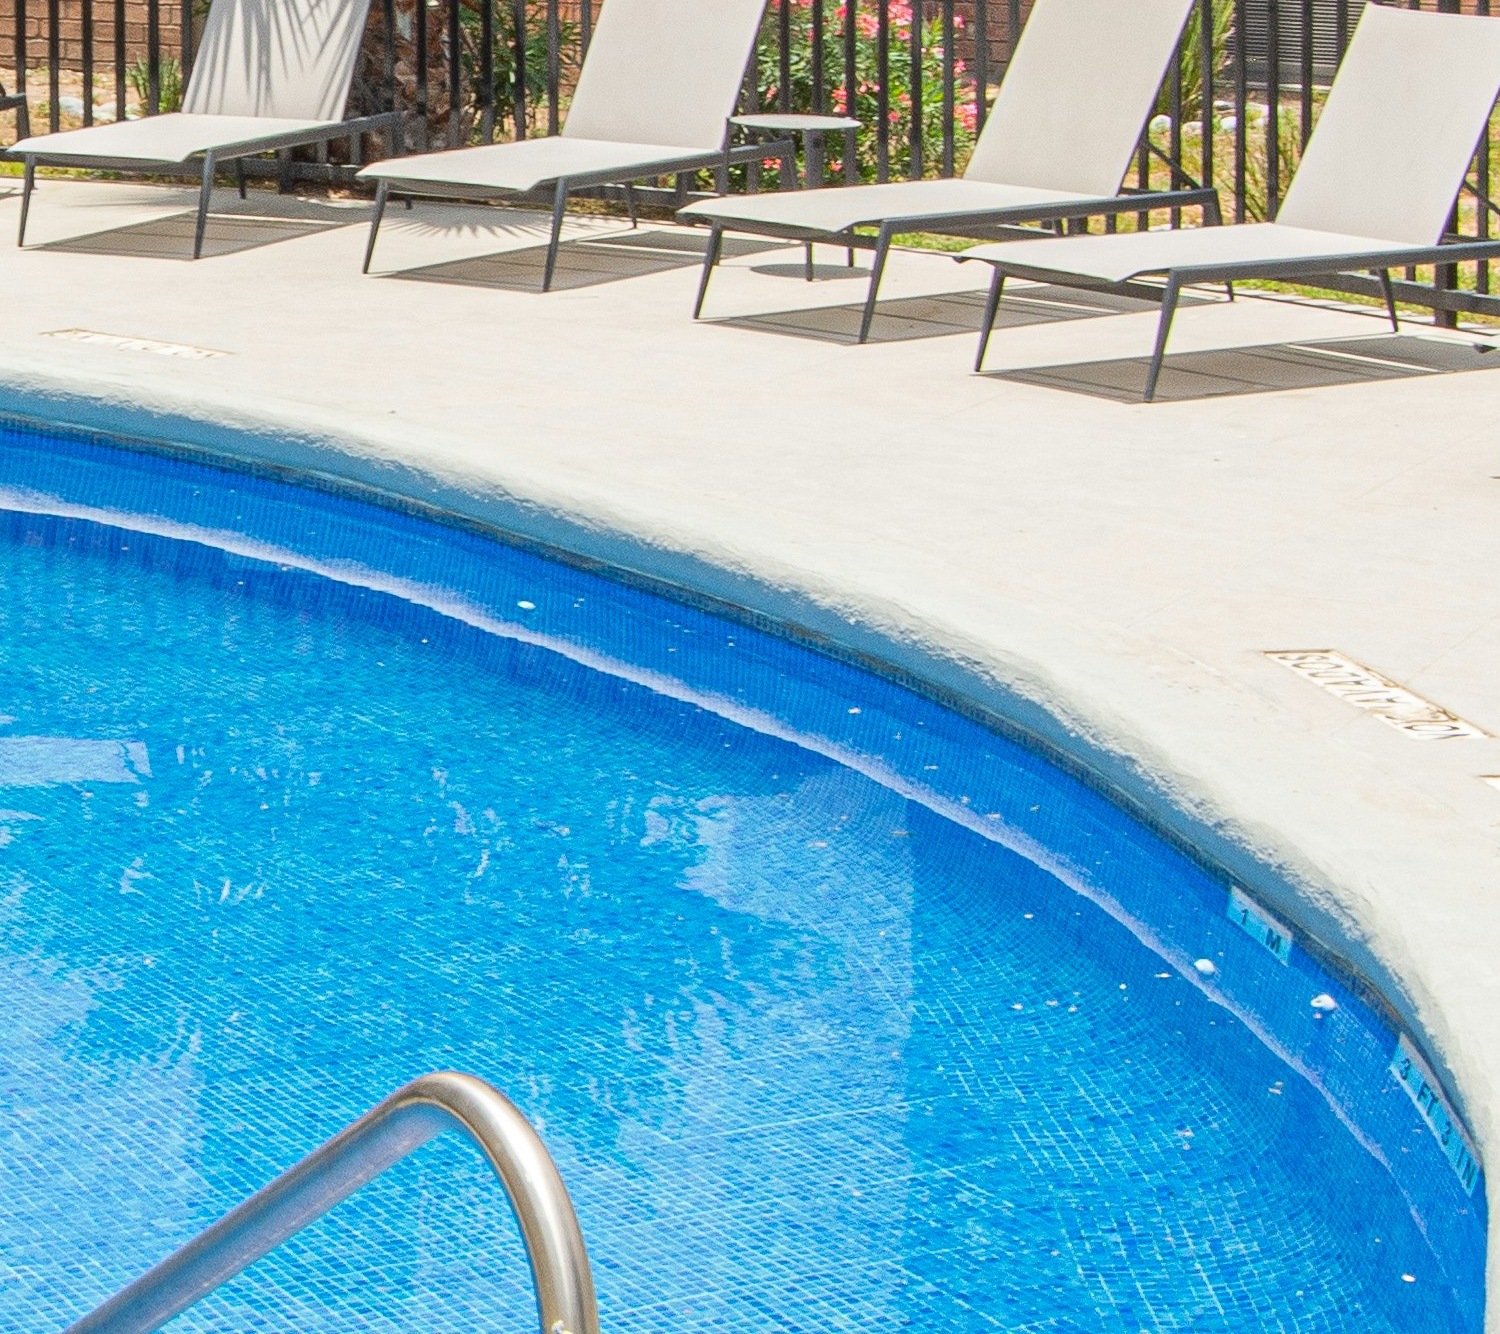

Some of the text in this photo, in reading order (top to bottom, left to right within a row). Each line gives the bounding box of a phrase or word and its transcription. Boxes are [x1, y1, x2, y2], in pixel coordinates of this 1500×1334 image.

[1241, 909, 1282, 954] 1 M
[1416, 1080, 1440, 1117] FT
